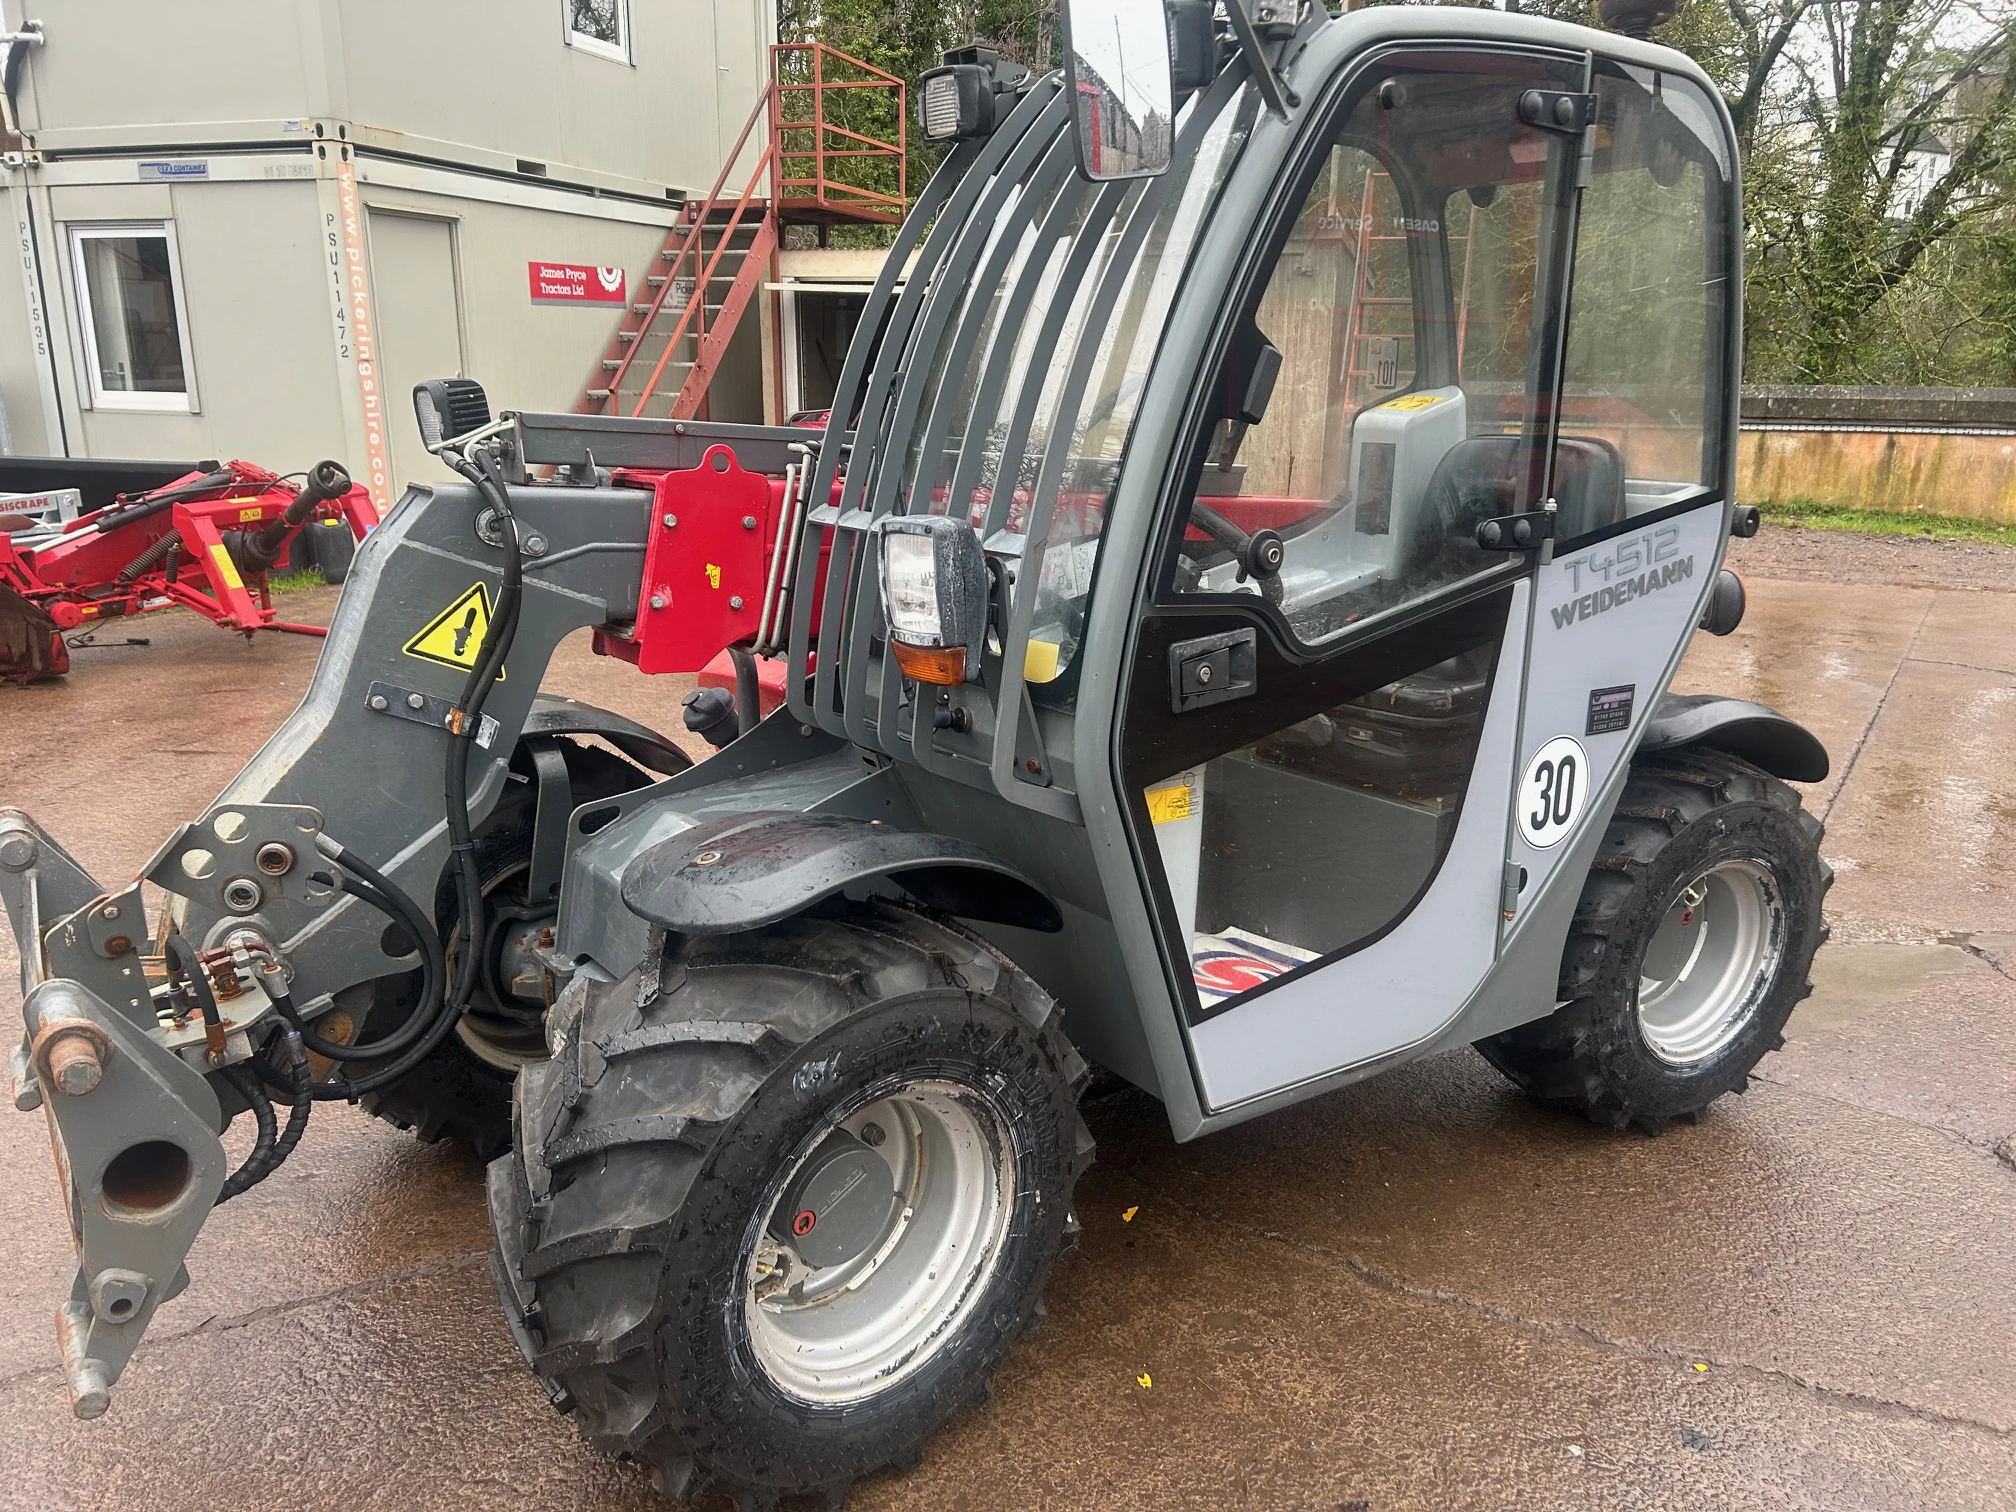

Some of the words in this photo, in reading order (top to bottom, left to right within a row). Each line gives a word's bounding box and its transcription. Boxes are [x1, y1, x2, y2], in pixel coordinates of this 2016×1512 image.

[174, 164, 206, 173] CONTAINEX
[540, 266, 565, 279] James
[565, 268, 587, 282] Pryce
[540, 282, 571, 295] Tractors
[572, 284, 585, 296] Ltd
[340, 172, 388, 519] www.pickeringshire.co.u
[1551, 555, 1693, 630] WEIDEMANN
[1565, 524, 1680, 593] T4512
[1531, 755, 1576, 831] 30
